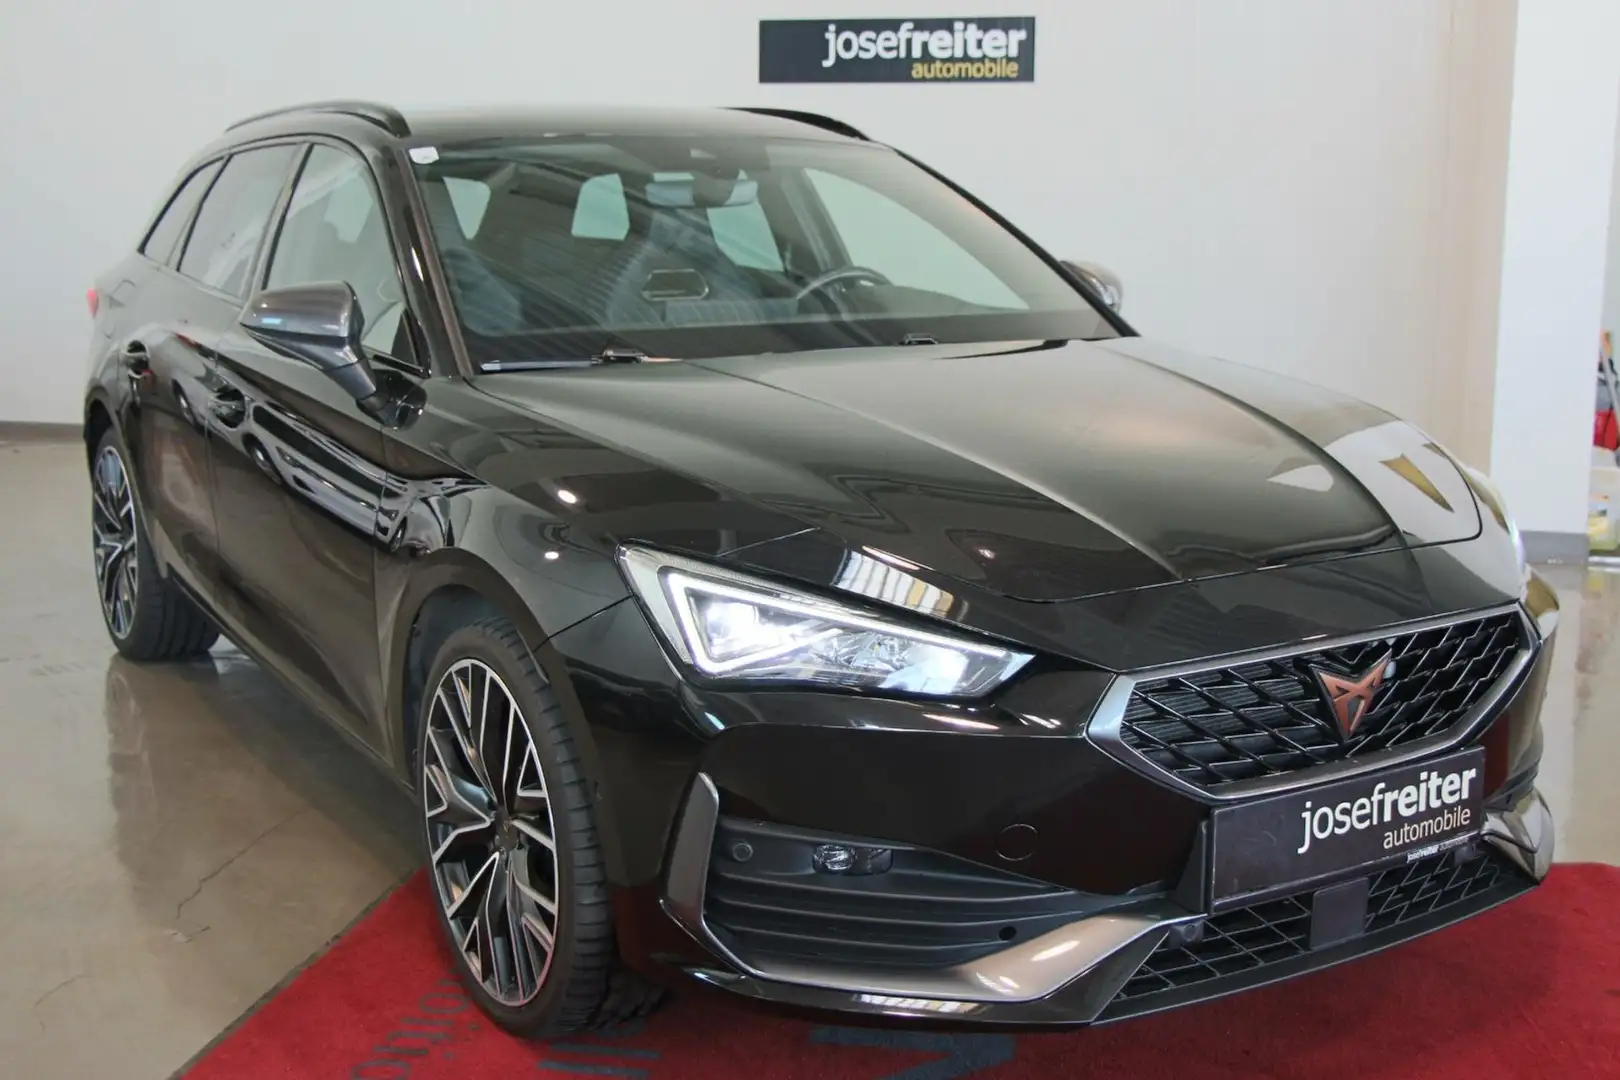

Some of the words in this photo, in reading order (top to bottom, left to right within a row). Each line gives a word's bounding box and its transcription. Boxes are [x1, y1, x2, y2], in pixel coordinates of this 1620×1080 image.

[822, 21, 1027, 68] josefreiter
[911, 59, 1019, 79] automobile
[1297, 768, 1477, 854] josefreiter
[1383, 805, 1471, 849] automobile
